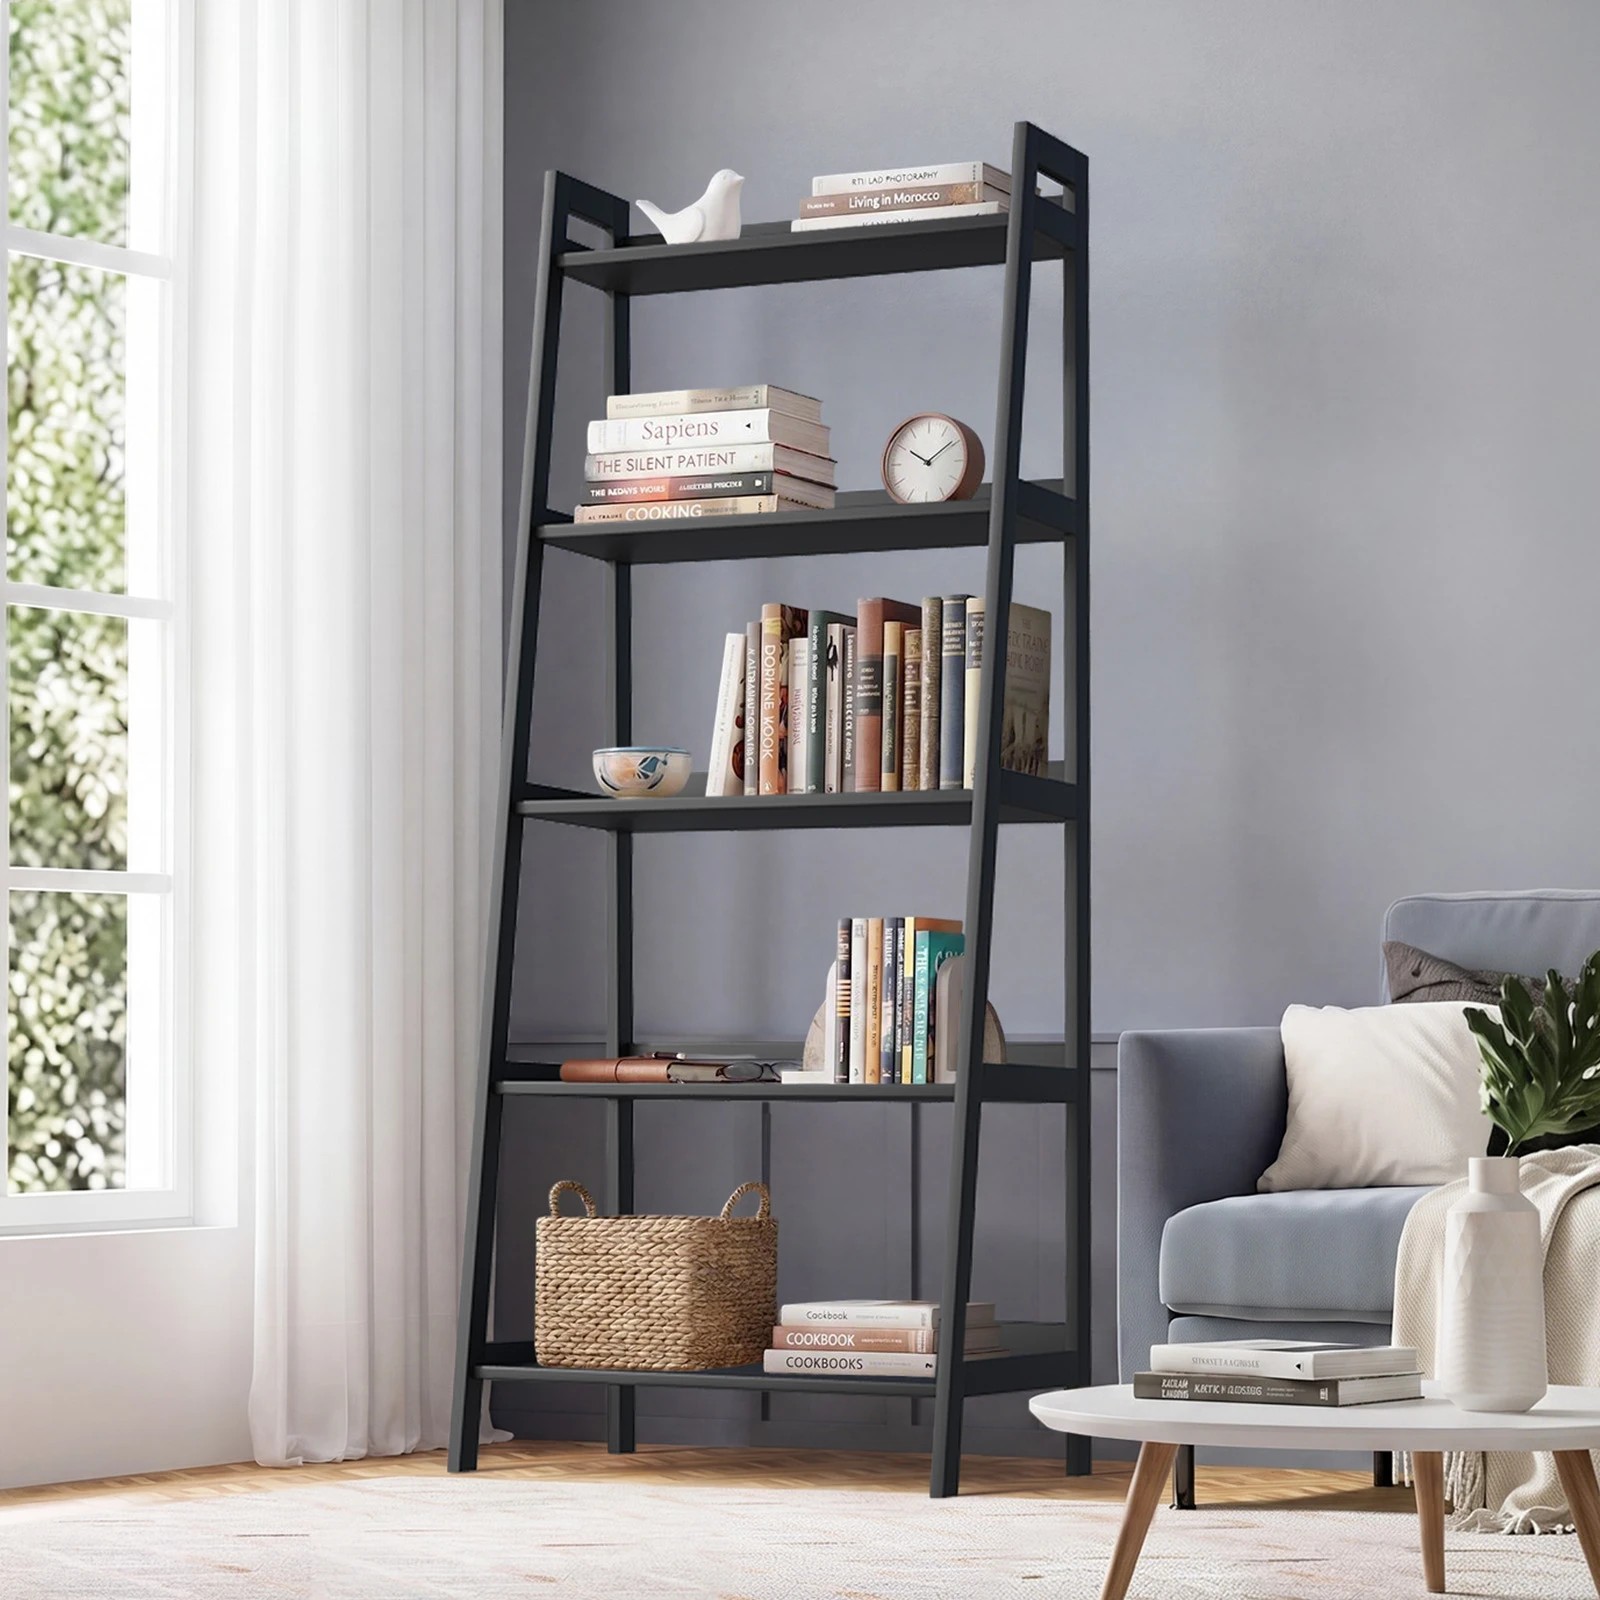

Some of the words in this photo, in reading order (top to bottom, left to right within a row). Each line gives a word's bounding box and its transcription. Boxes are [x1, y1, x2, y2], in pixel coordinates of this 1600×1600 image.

[849, 195, 880, 210] Living
[881, 194, 891, 206] in
[893, 191, 940, 204] Morocco
[642, 418, 719, 445] Sapiens
[596, 459, 622, 474] THE
[626, 455, 674, 472] SILENT
[679, 451, 737, 469] PATIENT
[590, 488, 606, 497] THE
[625, 504, 702, 521] COOKING
[806, 1310, 848, 1321] Cookbook
[786, 1332, 855, 1347] COOKBOOK
[786, 1356, 863, 1370] COOKBOOKS
